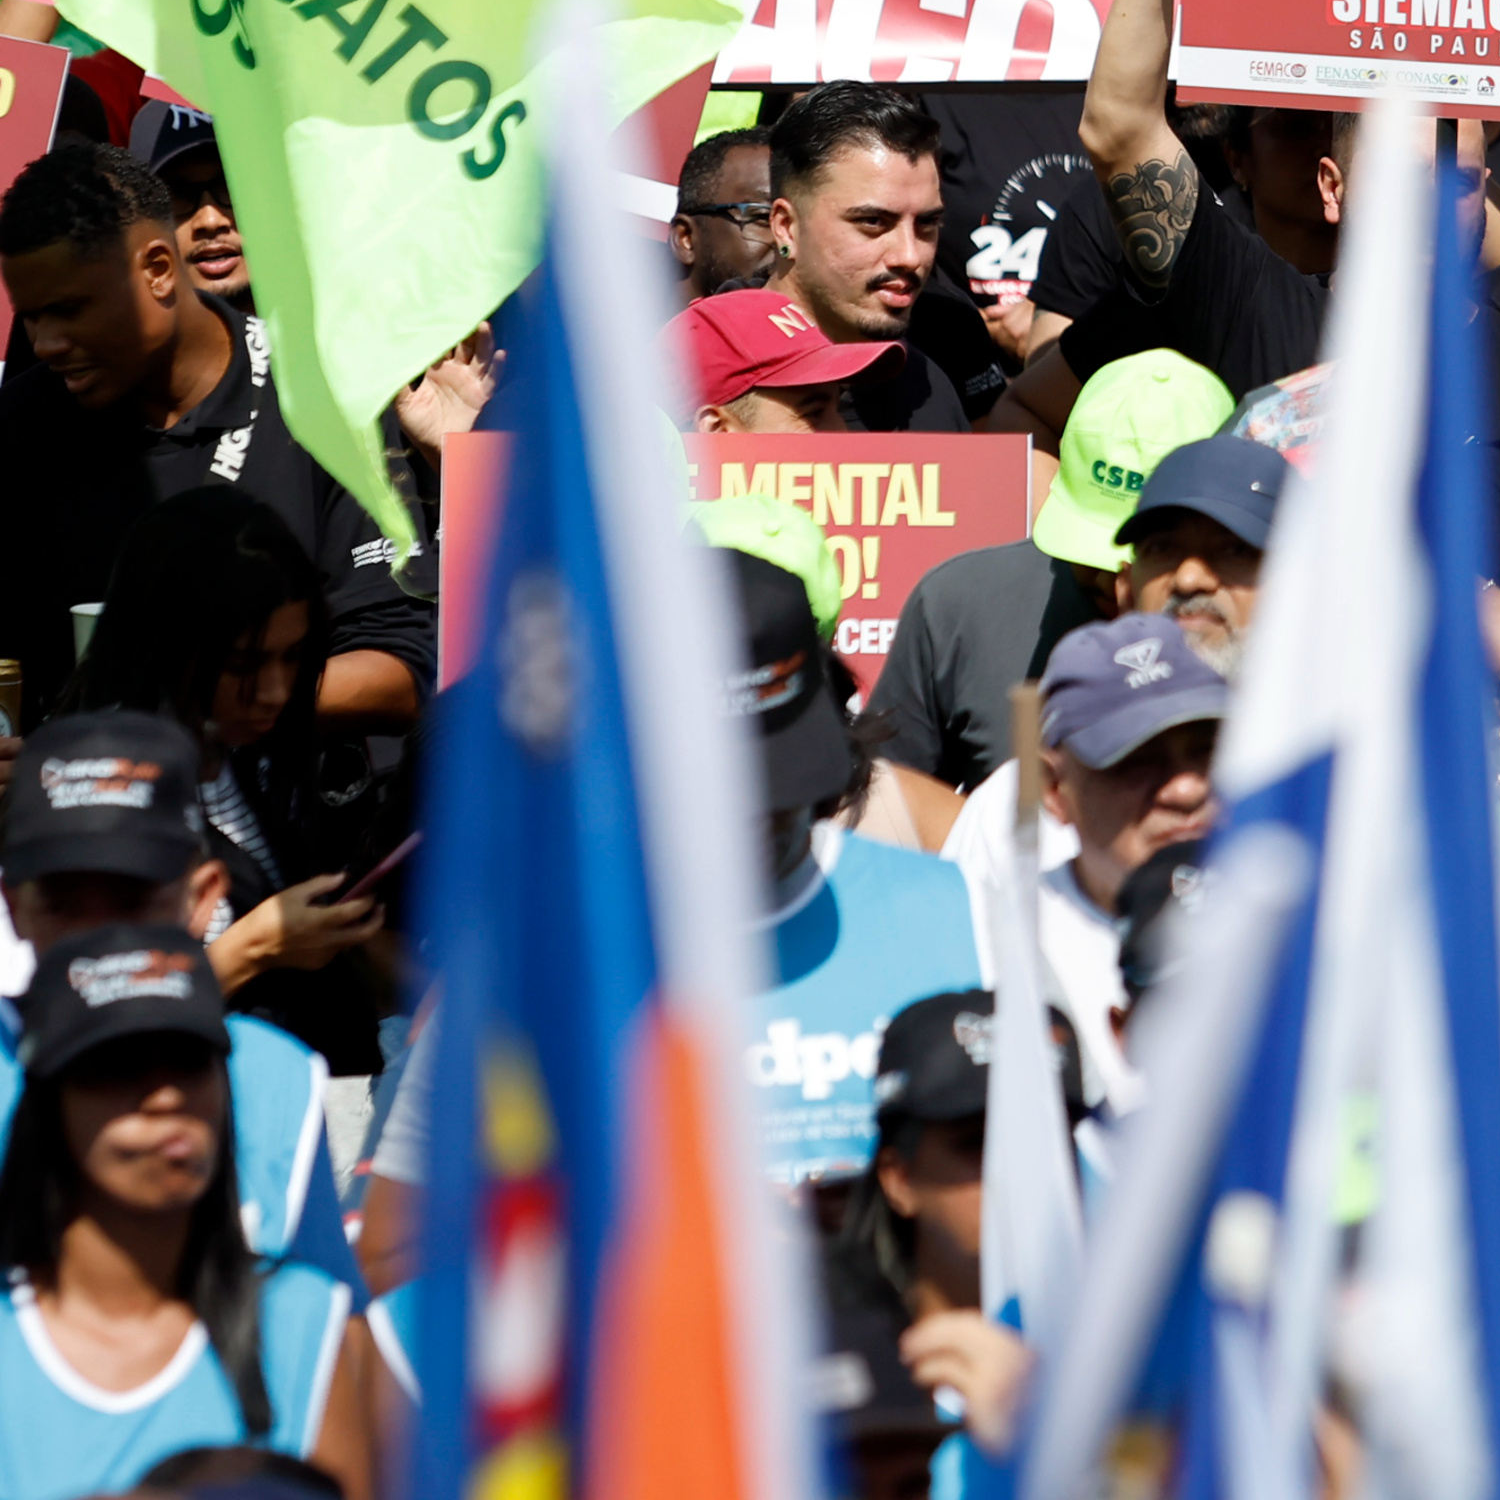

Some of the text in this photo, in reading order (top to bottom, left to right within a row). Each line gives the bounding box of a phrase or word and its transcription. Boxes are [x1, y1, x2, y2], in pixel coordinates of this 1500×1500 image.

[1350, 26, 1407, 52] SÃO
[1250, 61, 1306, 78] FEMACO
[966, 225, 1047, 281] 24
[1091, 460, 1145, 491] CSB
